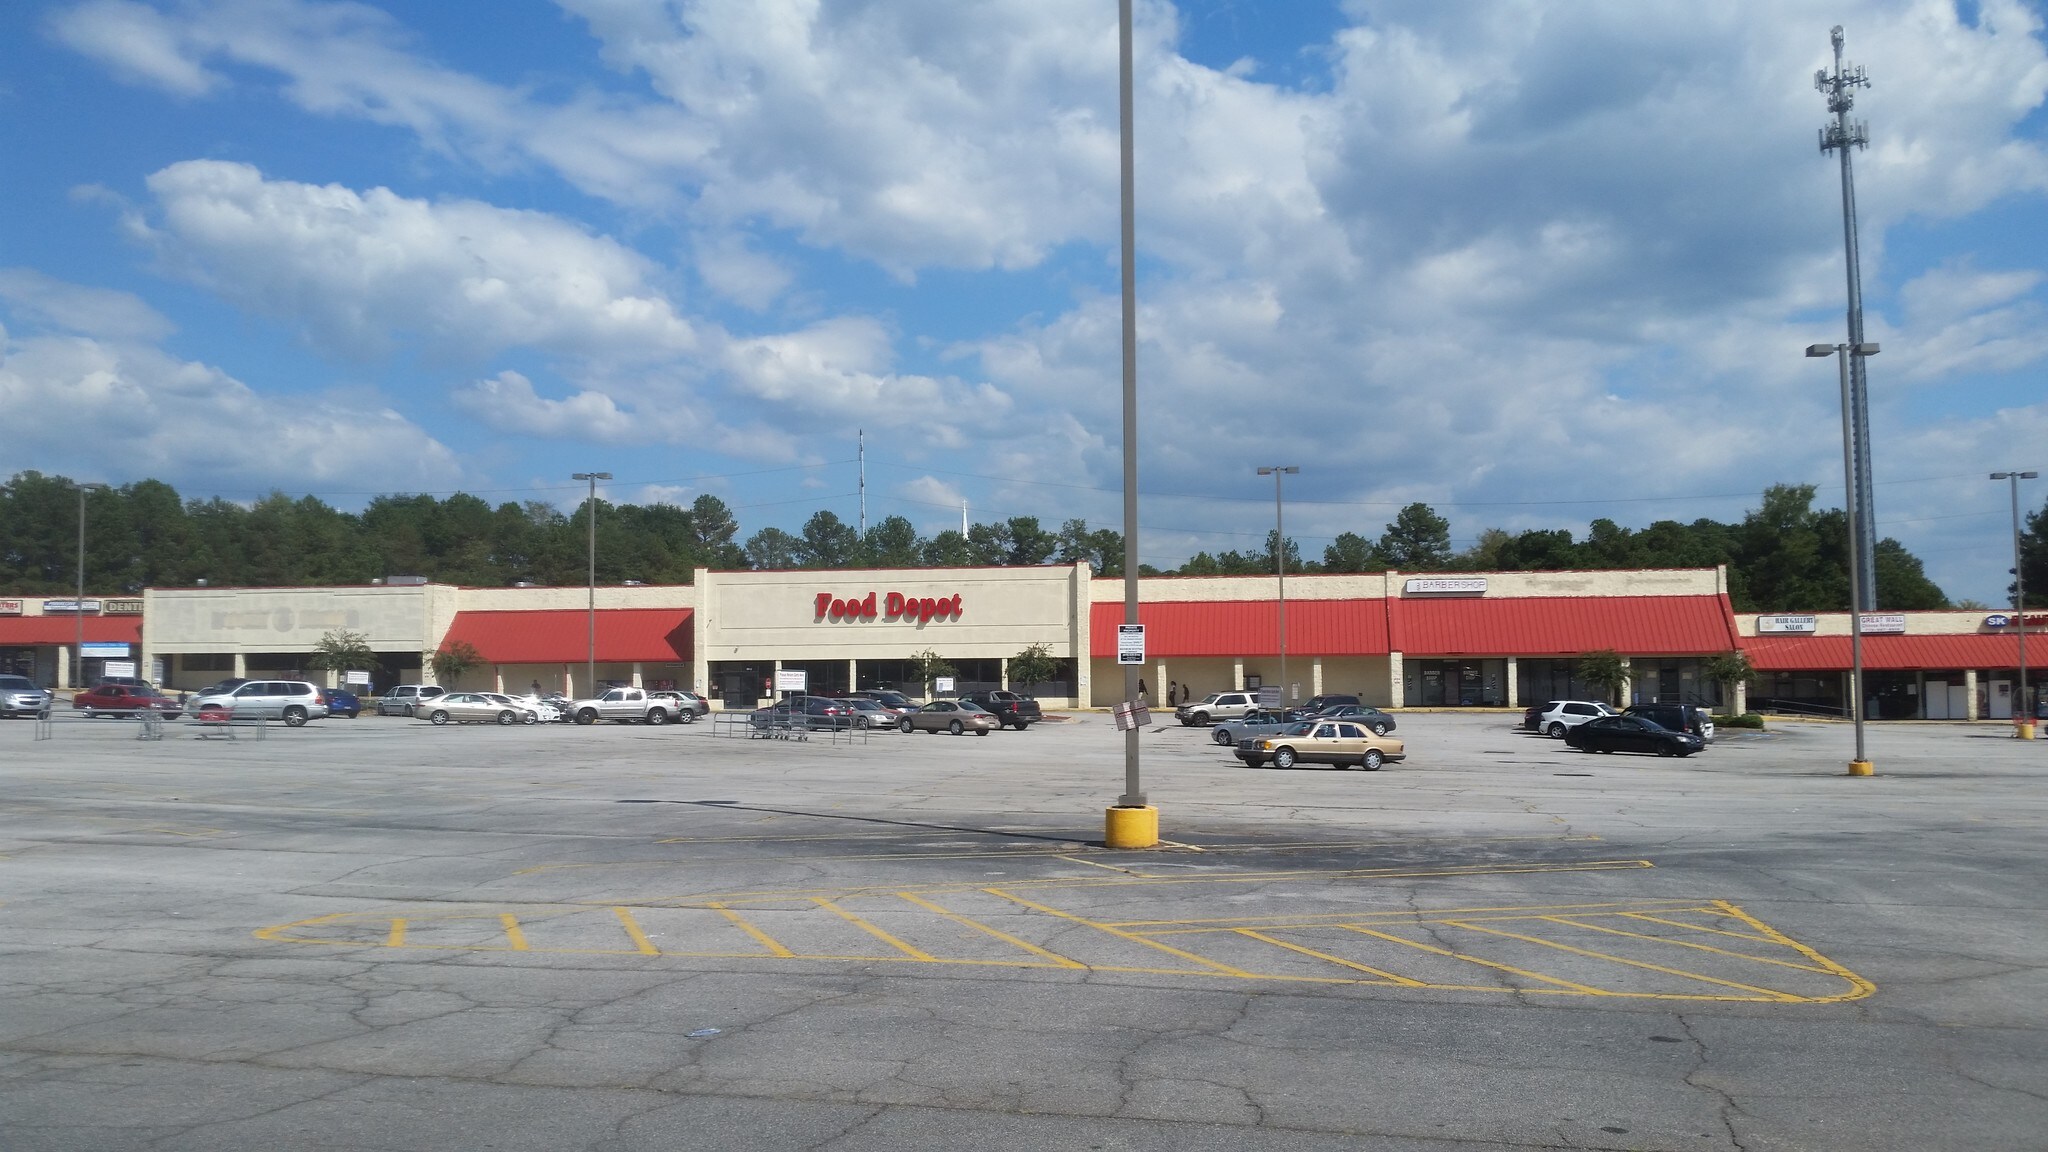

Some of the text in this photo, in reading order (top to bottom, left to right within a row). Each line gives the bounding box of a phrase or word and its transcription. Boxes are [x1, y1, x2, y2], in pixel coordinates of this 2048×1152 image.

[109, 602, 144, 611] DENTI
[816, 591, 963, 623] Food Depot
[1987, 617, 2006, 626] SK
